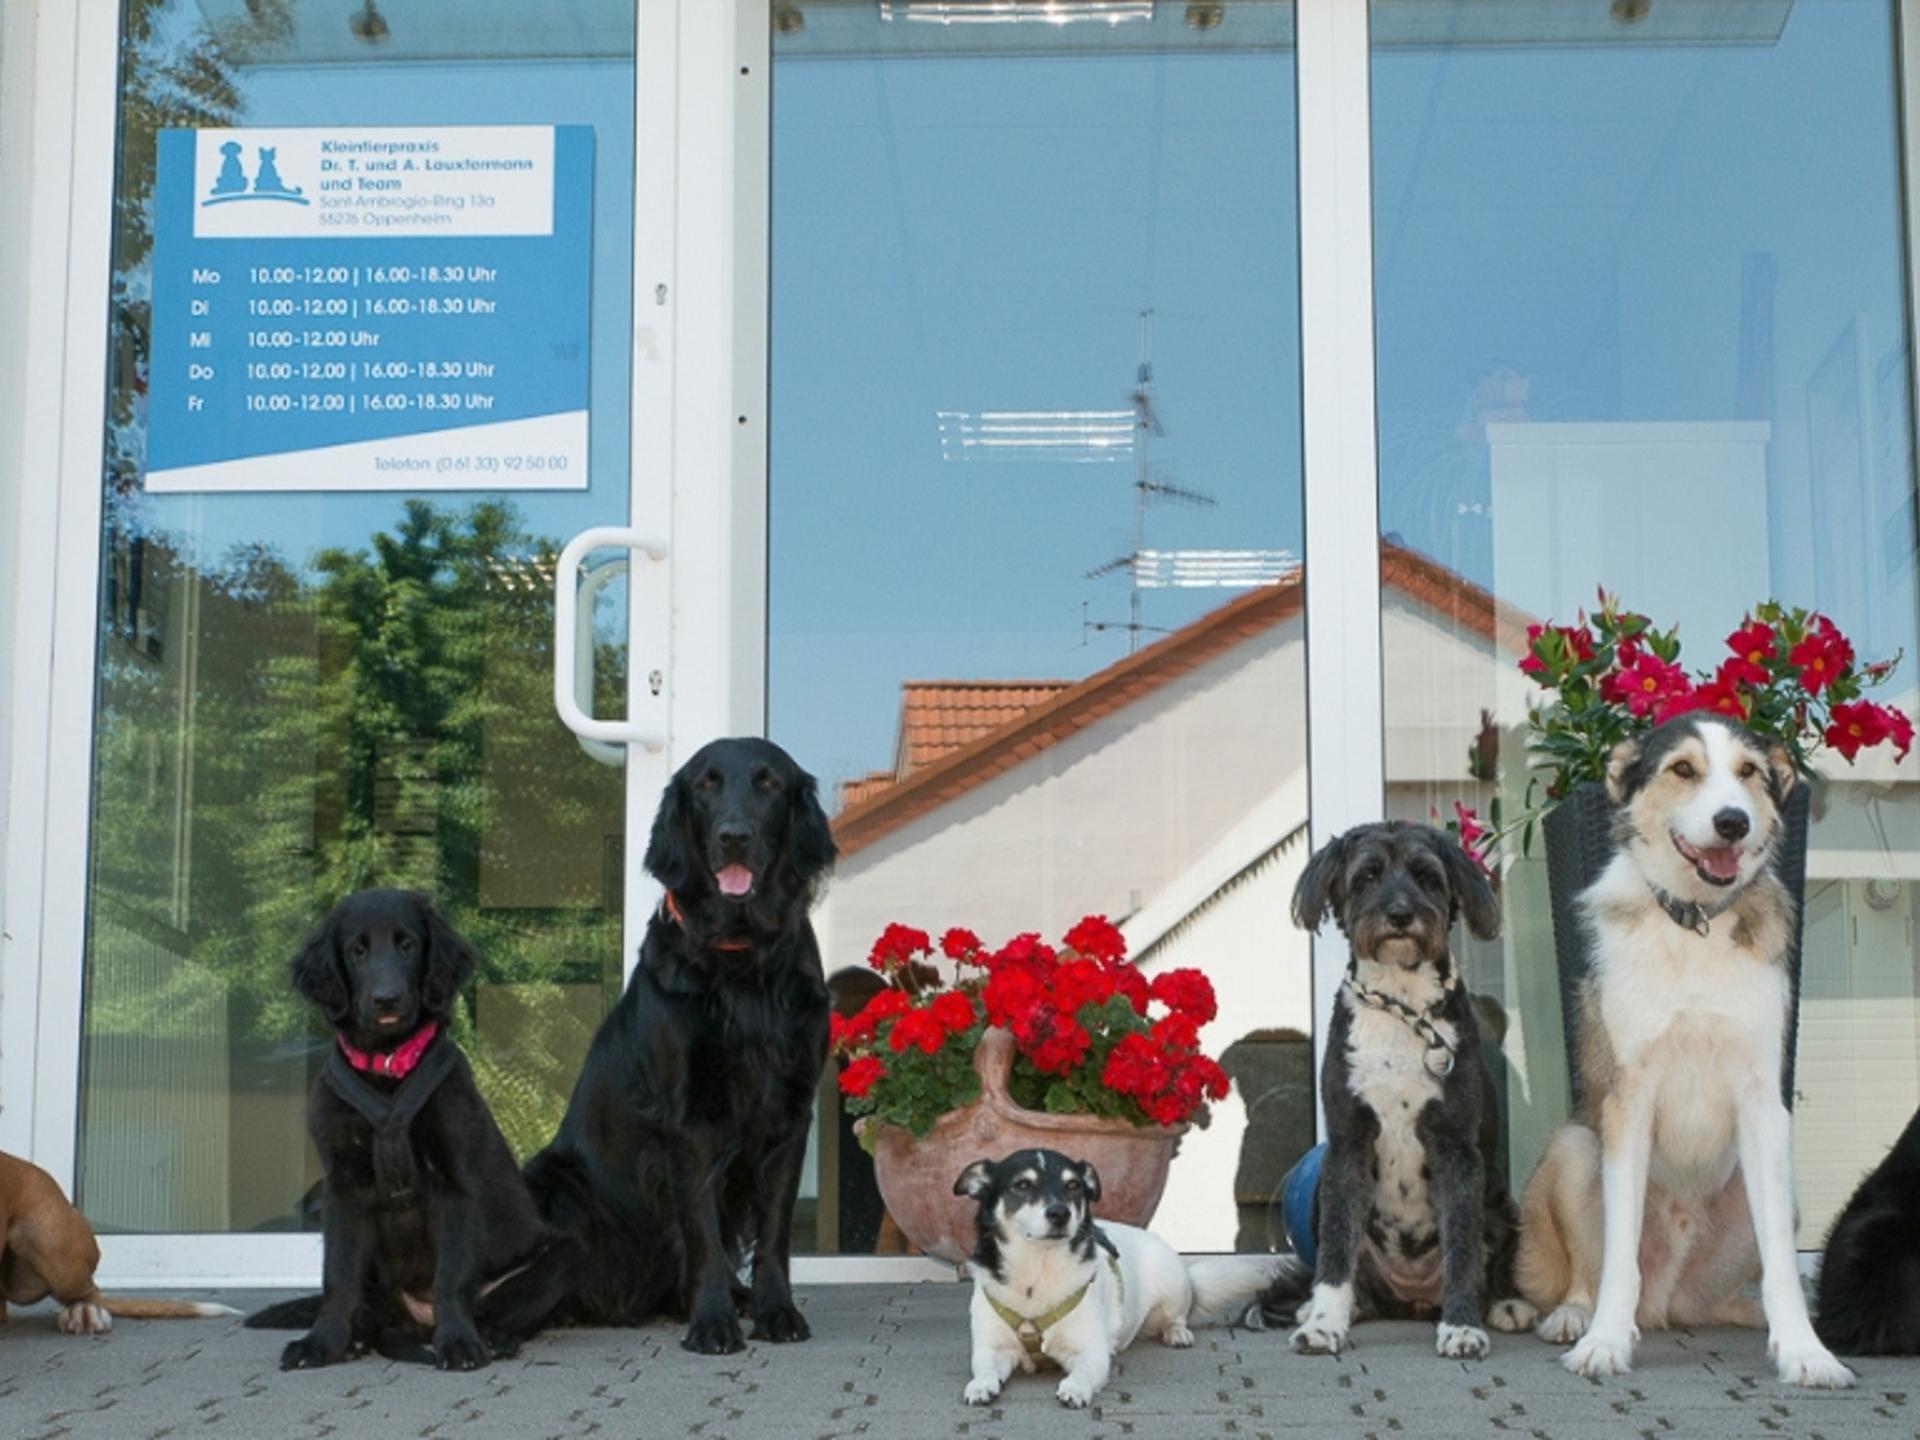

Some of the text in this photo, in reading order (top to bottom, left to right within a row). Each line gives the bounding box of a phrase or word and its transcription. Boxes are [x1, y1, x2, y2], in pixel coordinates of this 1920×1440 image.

[321, 140, 440, 155] Kleintierpraxis
[320, 158, 533, 172] Dr. T. und A. Lauxtermann
[321, 177, 402, 191] und Team
[364, 212, 452, 226] Oppenheim
[193, 269, 220, 284] Mo
[250, 268, 349, 283] 10.00-12.00
[366, 267, 464, 282] 16.00-18.30
[467, 267, 496, 282] Uhr
[191, 301, 208, 316] Di
[249, 300, 348, 315] 10.00-12.00
[365, 299, 463, 314] 16.00-18.30
[467, 299, 496, 314] Uhr
[190, 331, 380, 348] Mi 10.00-12.00 Uhr
[189, 365, 214, 380] Do
[247, 364, 345, 379] 10.00-12.00
[363, 362, 461, 377] 16.00-18.30
[465, 362, 495, 377] Uhr
[188, 396, 205, 411] Fr
[246, 395, 345, 410] 10.00-12.00
[362, 394, 461, 409] 16.00-18.30
[465, 394, 494, 409] Uhr
